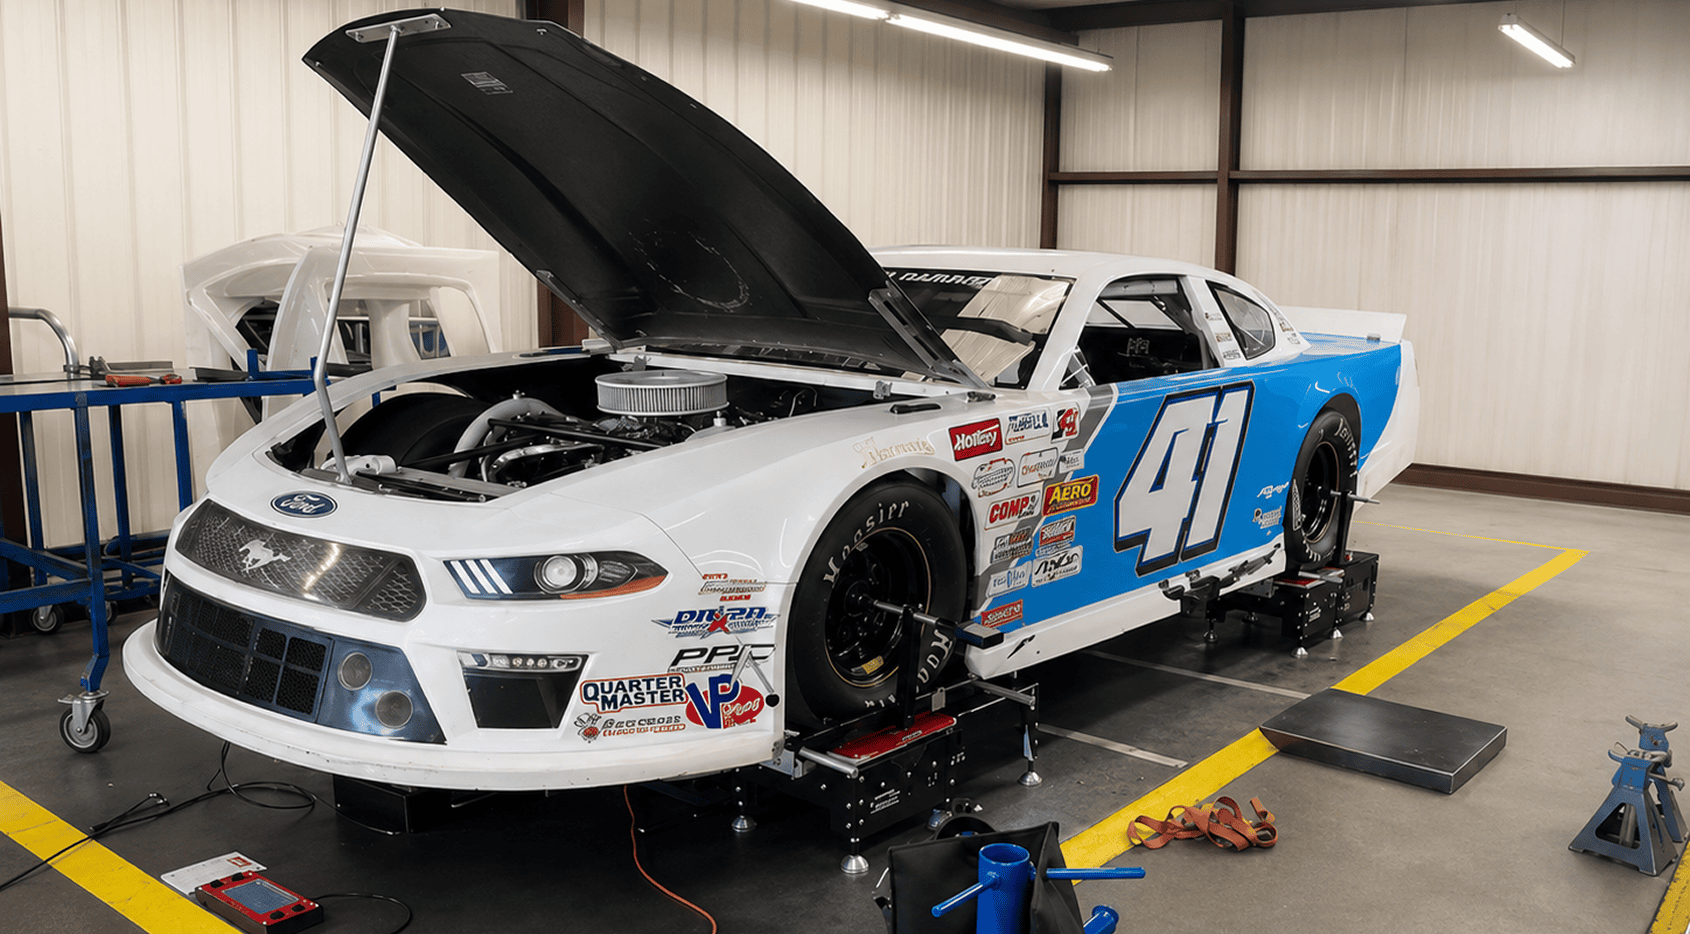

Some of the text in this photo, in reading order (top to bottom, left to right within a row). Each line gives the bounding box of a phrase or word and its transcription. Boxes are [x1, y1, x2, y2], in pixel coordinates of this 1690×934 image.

[1115, 382, 1254, 577] 41
[1048, 482, 1091, 505] AERO
[989, 496, 1030, 524] COMP
[583, 676, 682, 701] QUARTER
[601, 688, 685, 711] MASTER
[685, 673, 740, 729] VP
